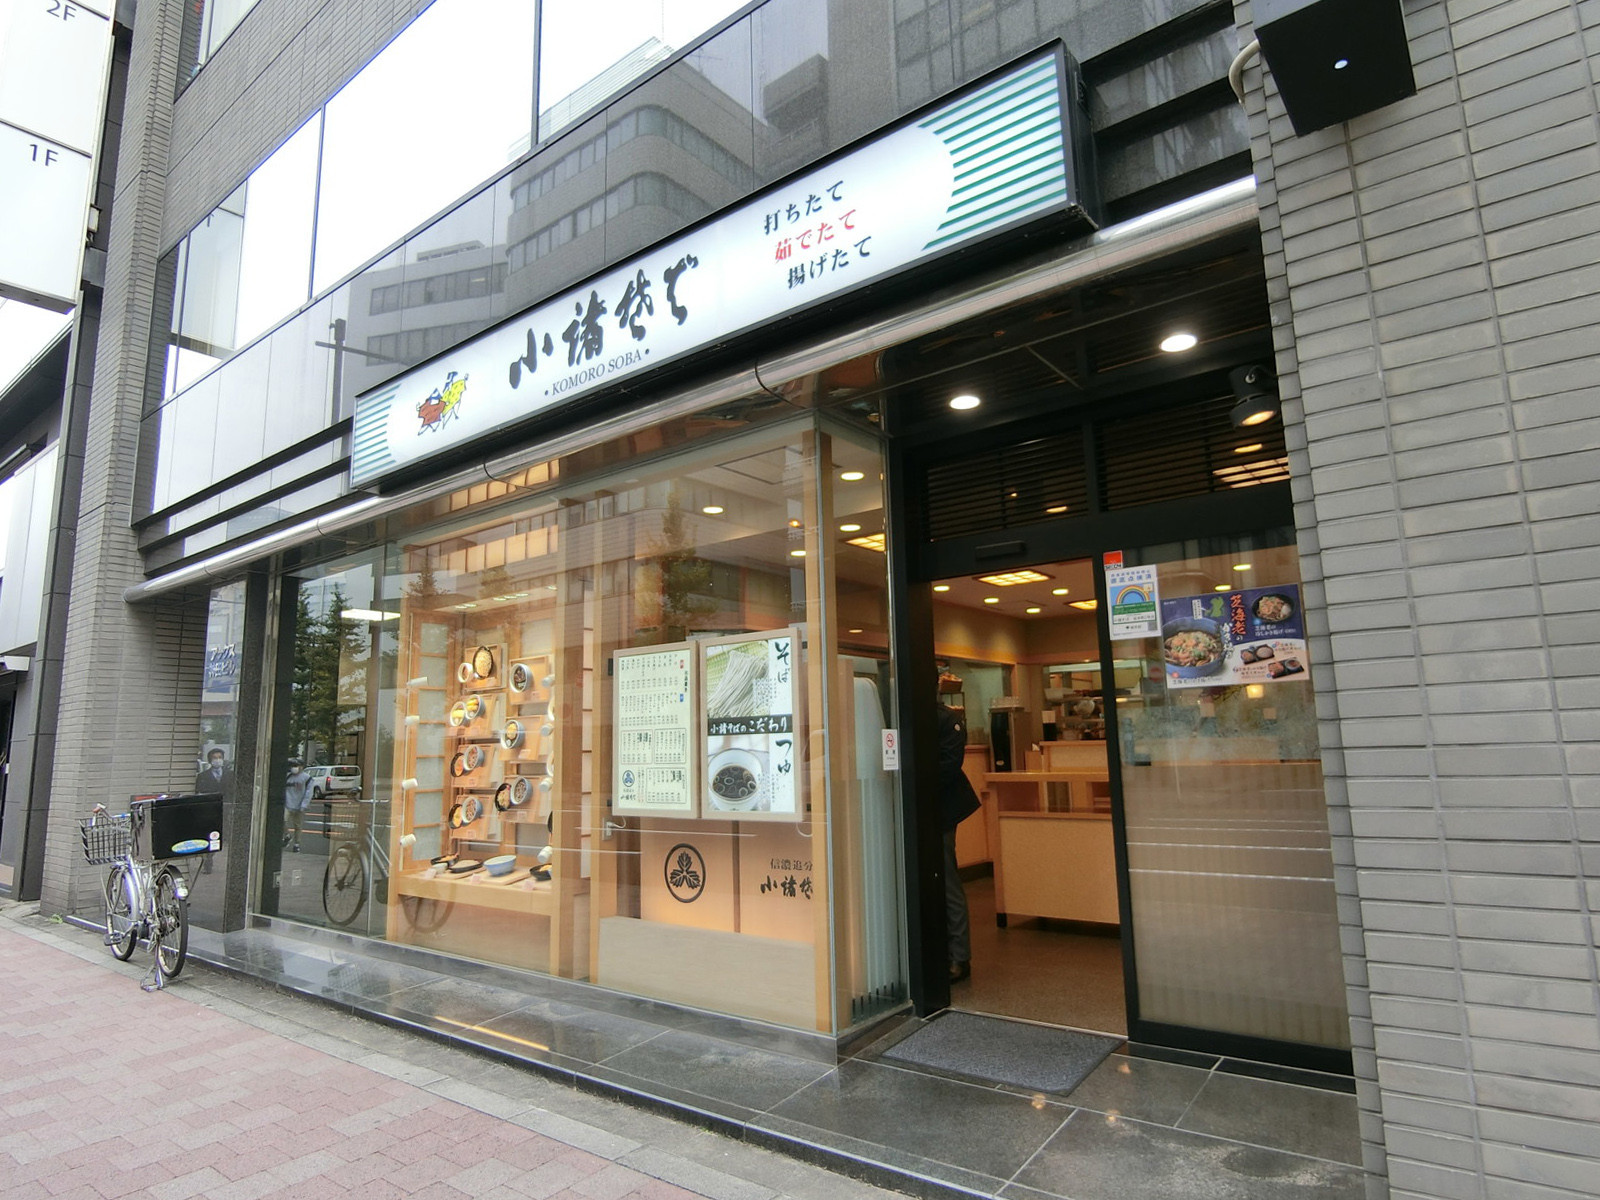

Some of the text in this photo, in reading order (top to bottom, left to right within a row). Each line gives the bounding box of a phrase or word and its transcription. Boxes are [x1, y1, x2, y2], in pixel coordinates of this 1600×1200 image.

[47, 0, 77, 21] 2F
[30, 144, 59, 166] 1F
[764, 180, 844, 235] 打ちたて
[775, 209, 856, 264] 茹でたて
[788, 236, 871, 289] 揚げたて
[552, 349, 642, 396] KOMORO SOBA
[775, 642, 790, 683] そば
[776, 739, 792, 775] つゆ
[771, 858, 813, 871] 信濃追分
